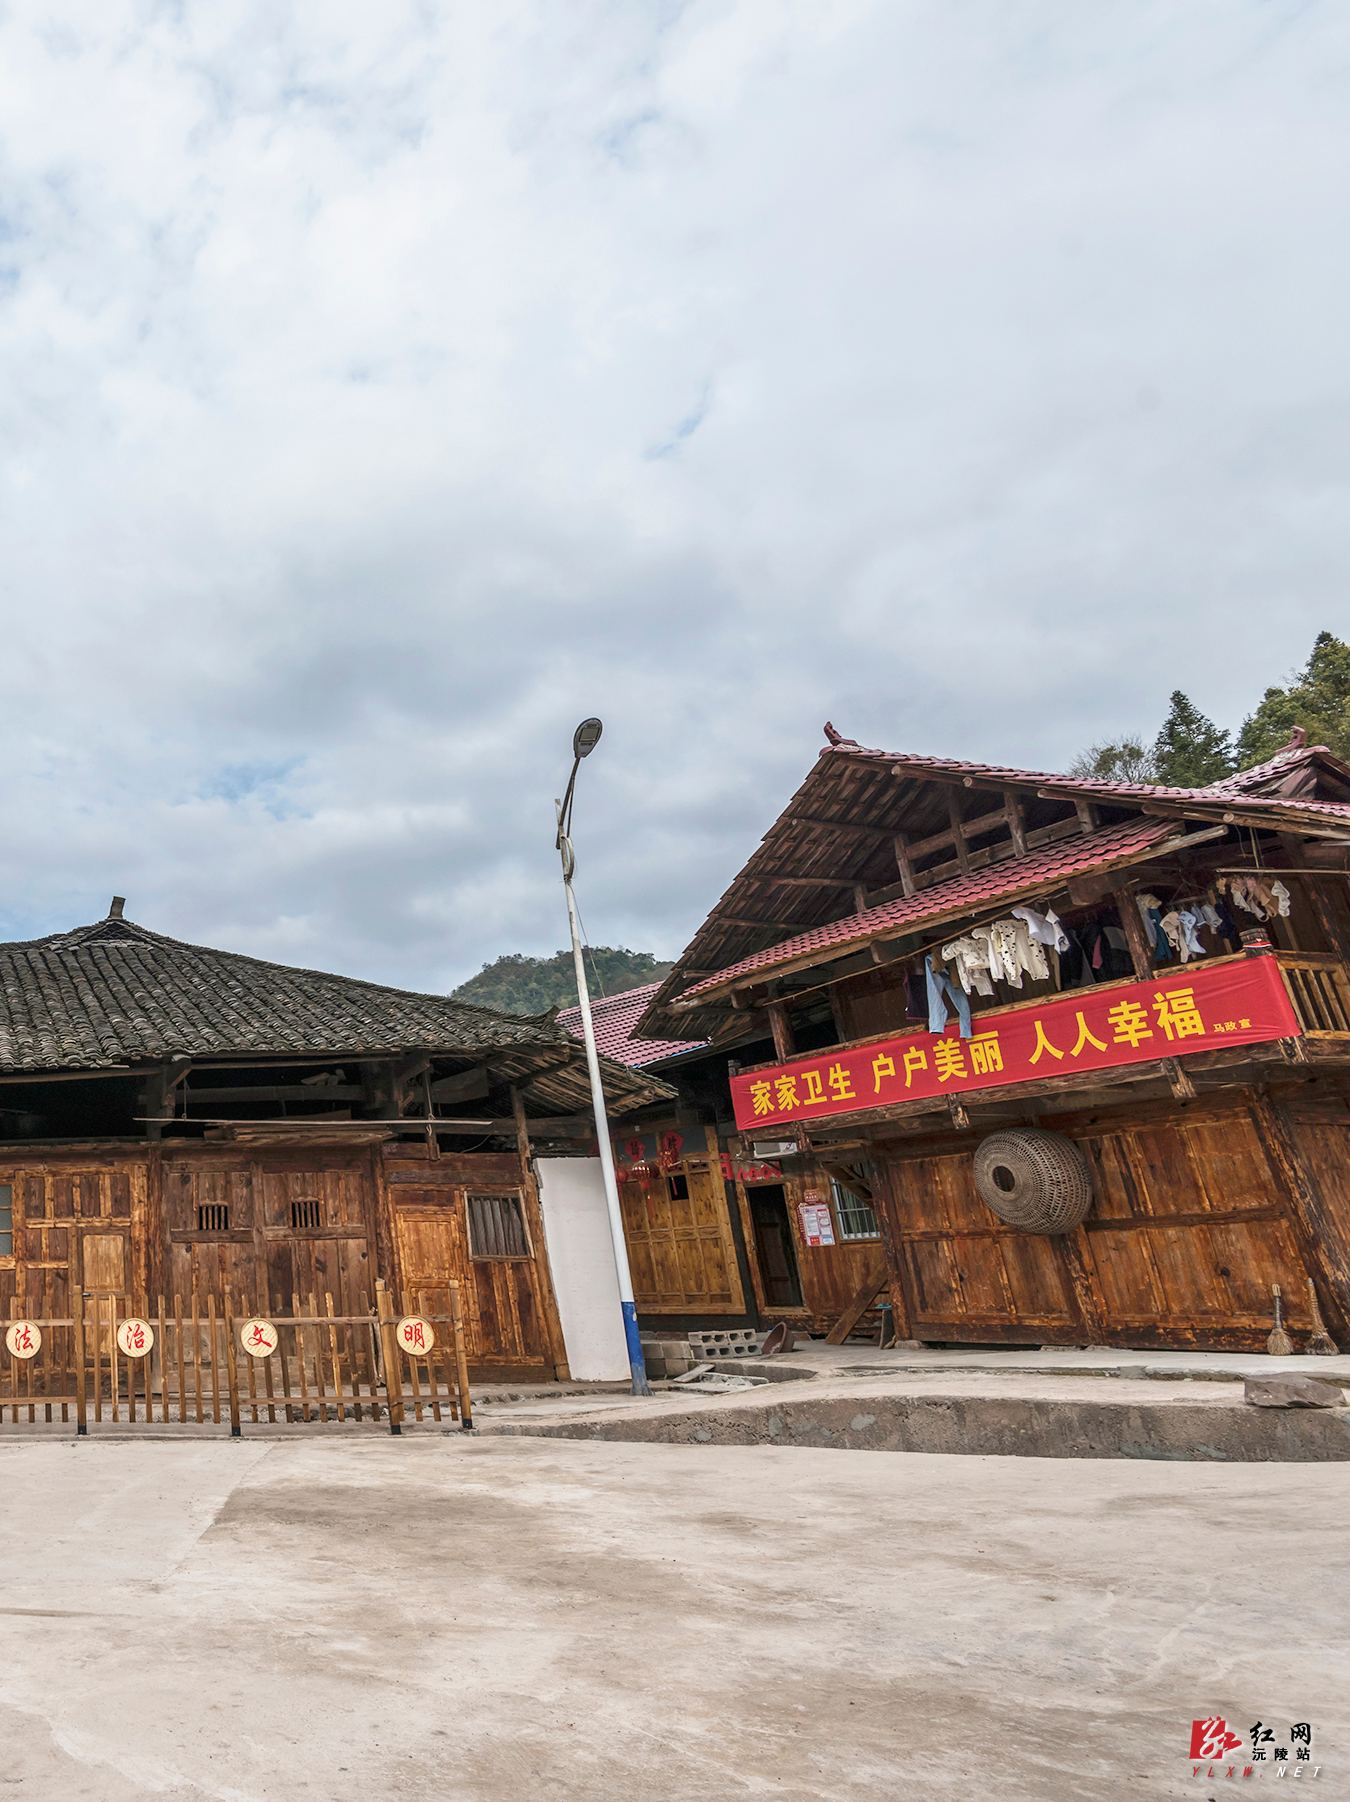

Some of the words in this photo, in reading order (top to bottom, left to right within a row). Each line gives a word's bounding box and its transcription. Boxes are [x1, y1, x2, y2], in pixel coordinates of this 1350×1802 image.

[749, 1062, 856, 1116] 家家卫生
[871, 1030, 1004, 1094] 户户美丽
[1028, 987, 1206, 1065] 人人幸福
[14, 1324, 34, 1352] 法
[126, 1323, 145, 1350] 治
[248, 1324, 273, 1348] 文
[403, 1321, 426, 1350] 明
